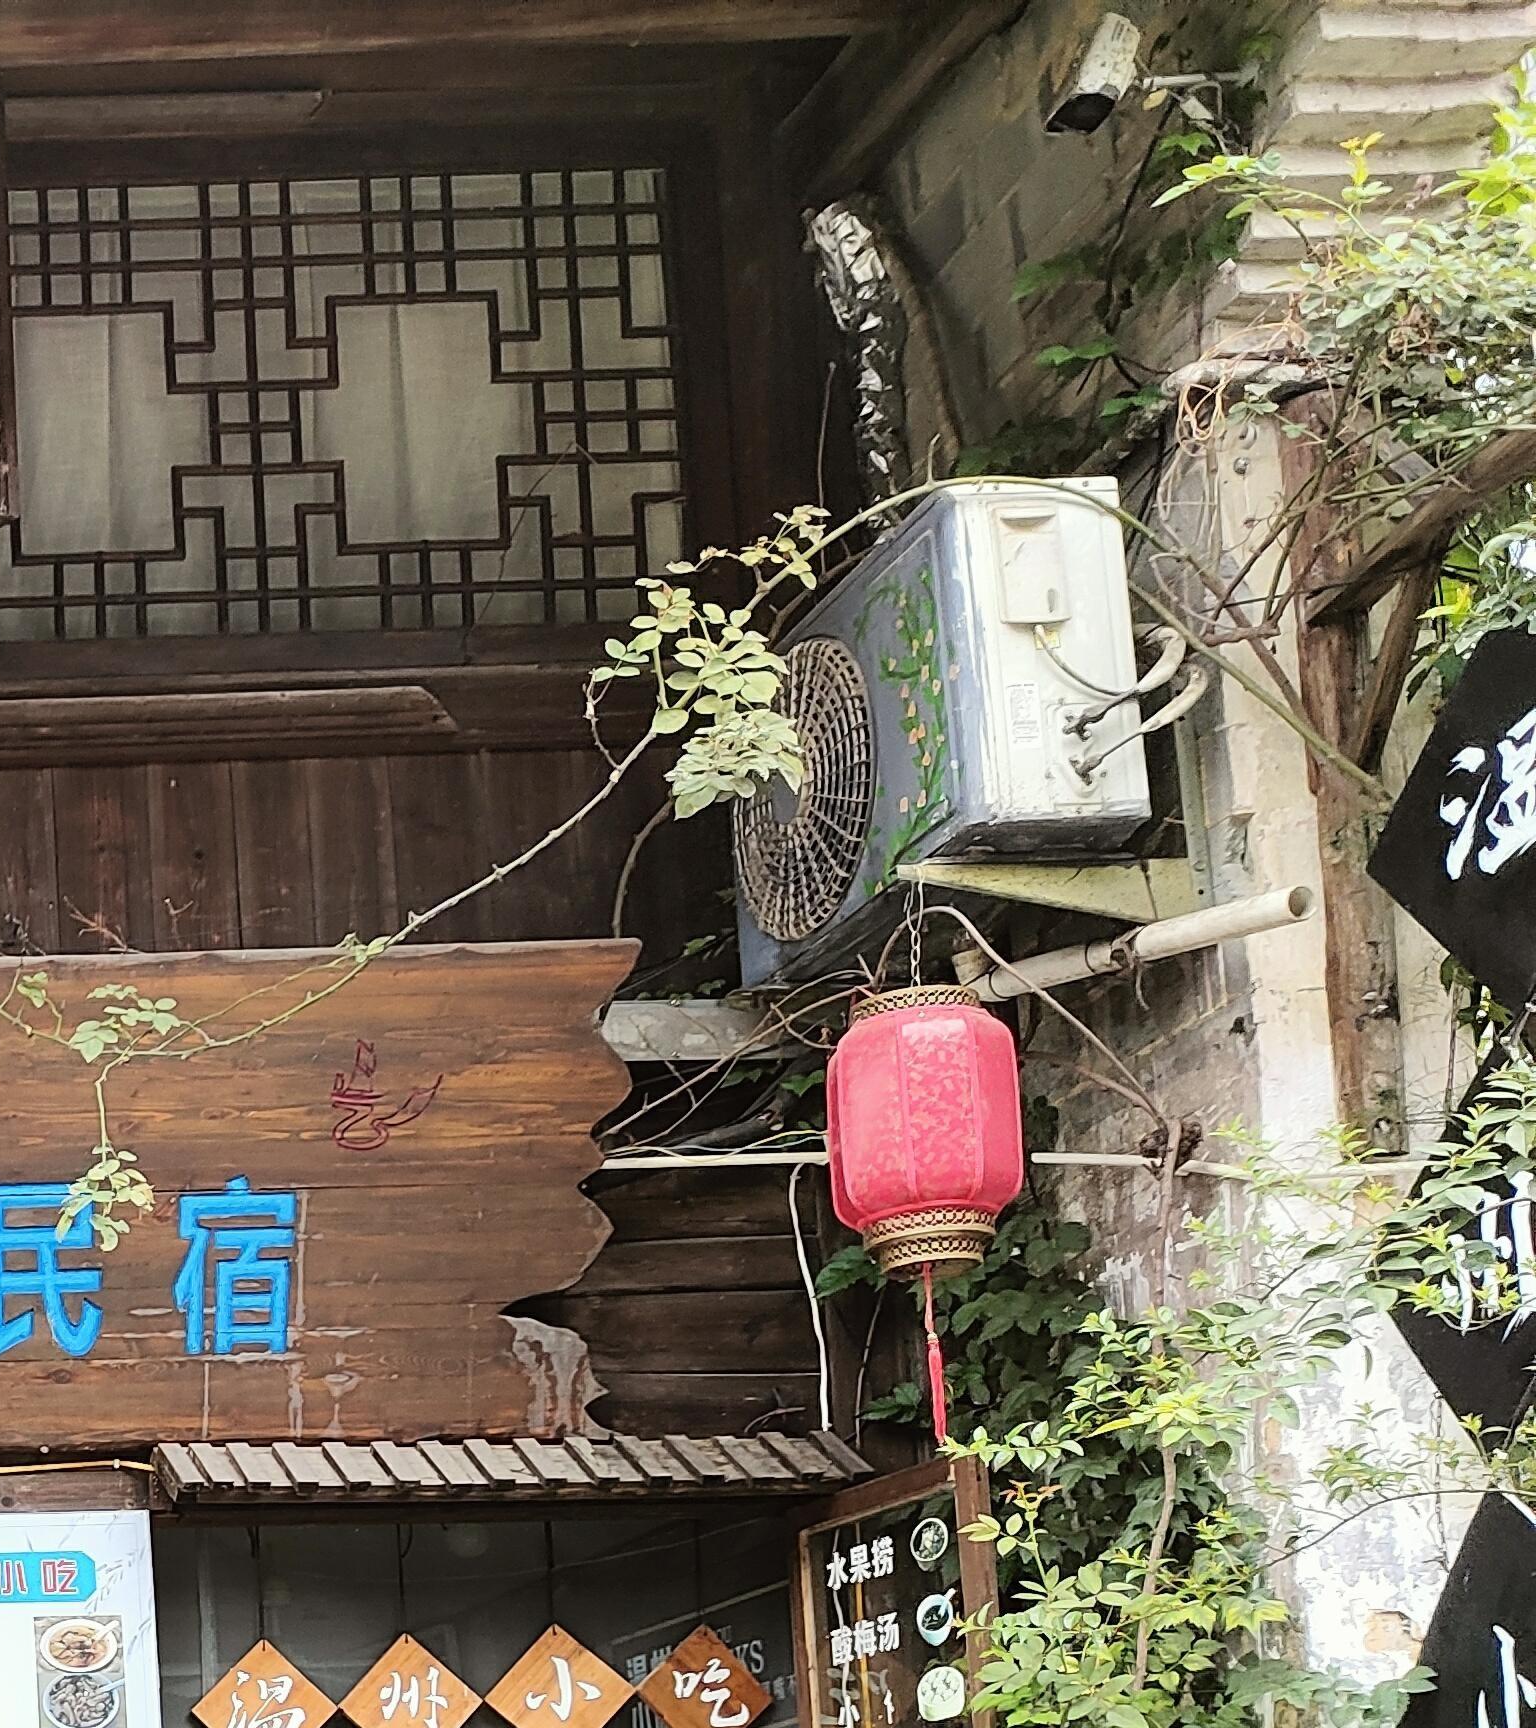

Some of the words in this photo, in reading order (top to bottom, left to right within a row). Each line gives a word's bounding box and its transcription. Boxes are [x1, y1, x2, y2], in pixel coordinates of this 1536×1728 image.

[826, 1535, 895, 1591] 水果捞
[829, 1611, 901, 1667] 酸梅汤
